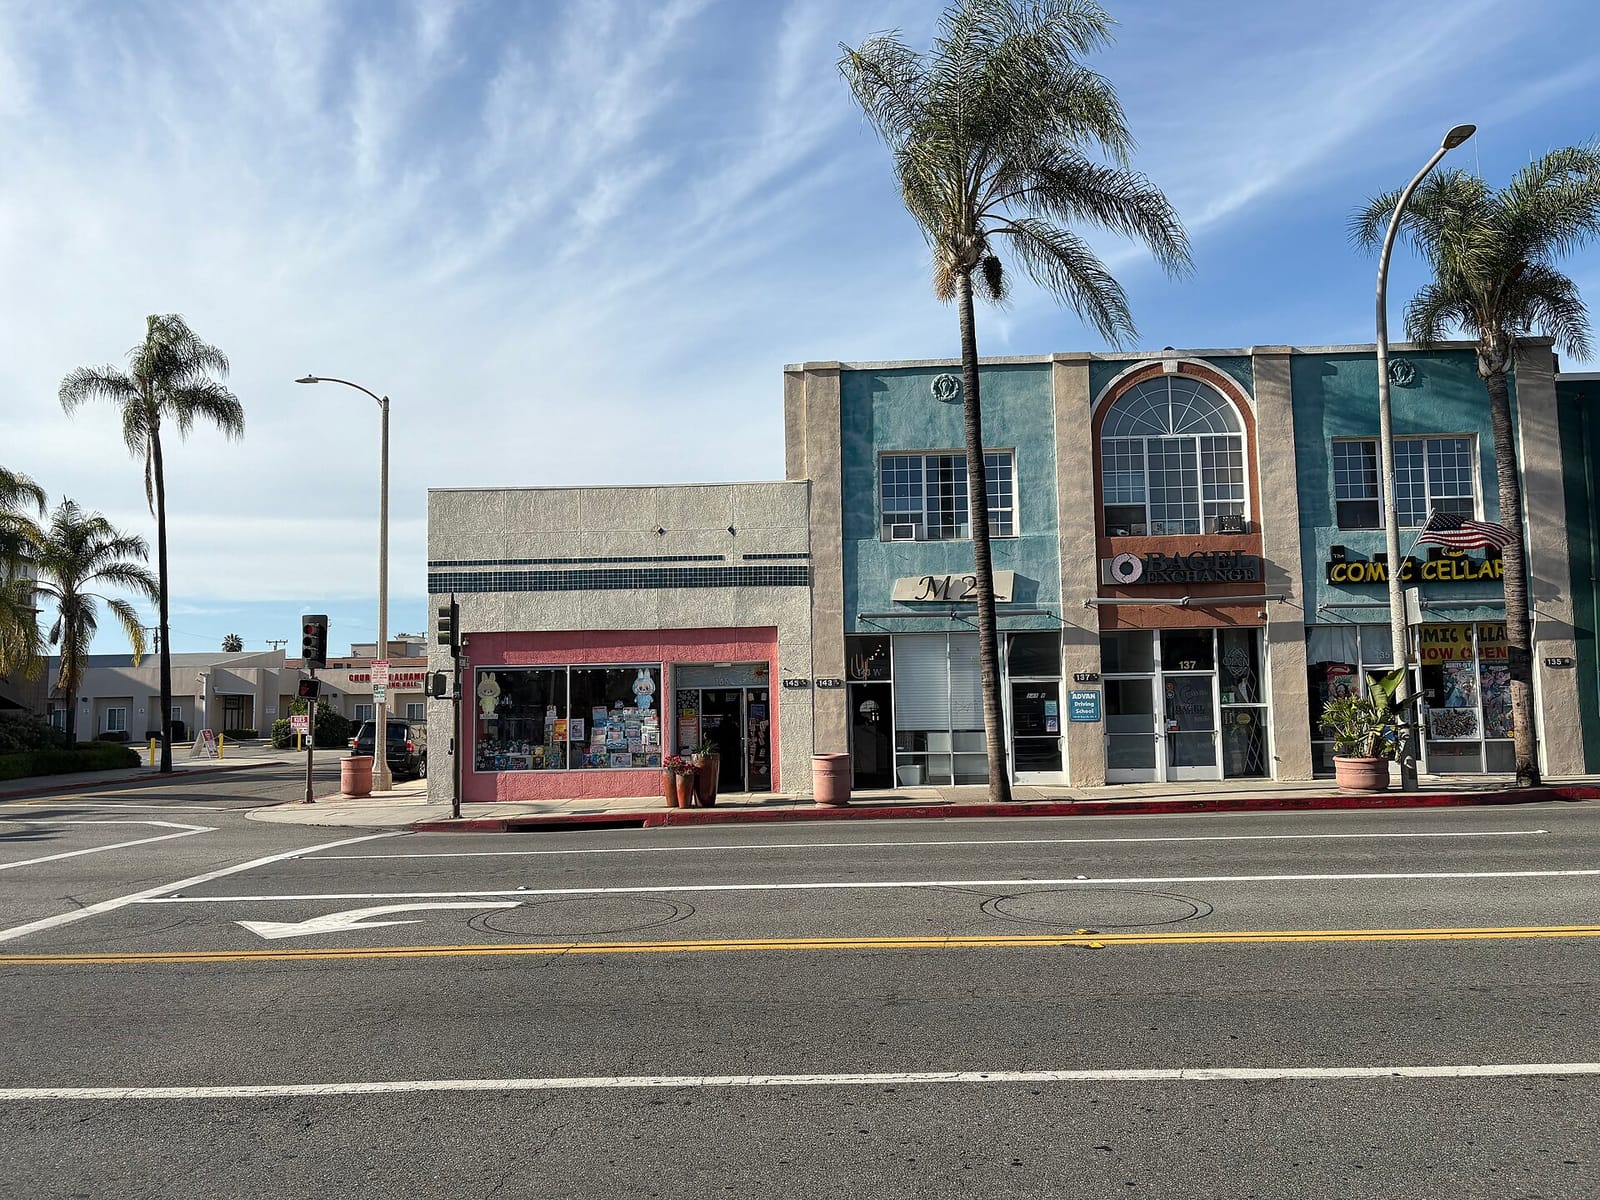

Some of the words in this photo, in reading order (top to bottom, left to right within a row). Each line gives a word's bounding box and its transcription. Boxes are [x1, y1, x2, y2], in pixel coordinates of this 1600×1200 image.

[1144, 550, 1254, 571] BAGEL
[1145, 569, 1256, 583] EXCHANGE
[1331, 562, 1412, 582] COMC
[1178, 660, 1197, 670] 137
[348, 673, 371, 682] CHUR
